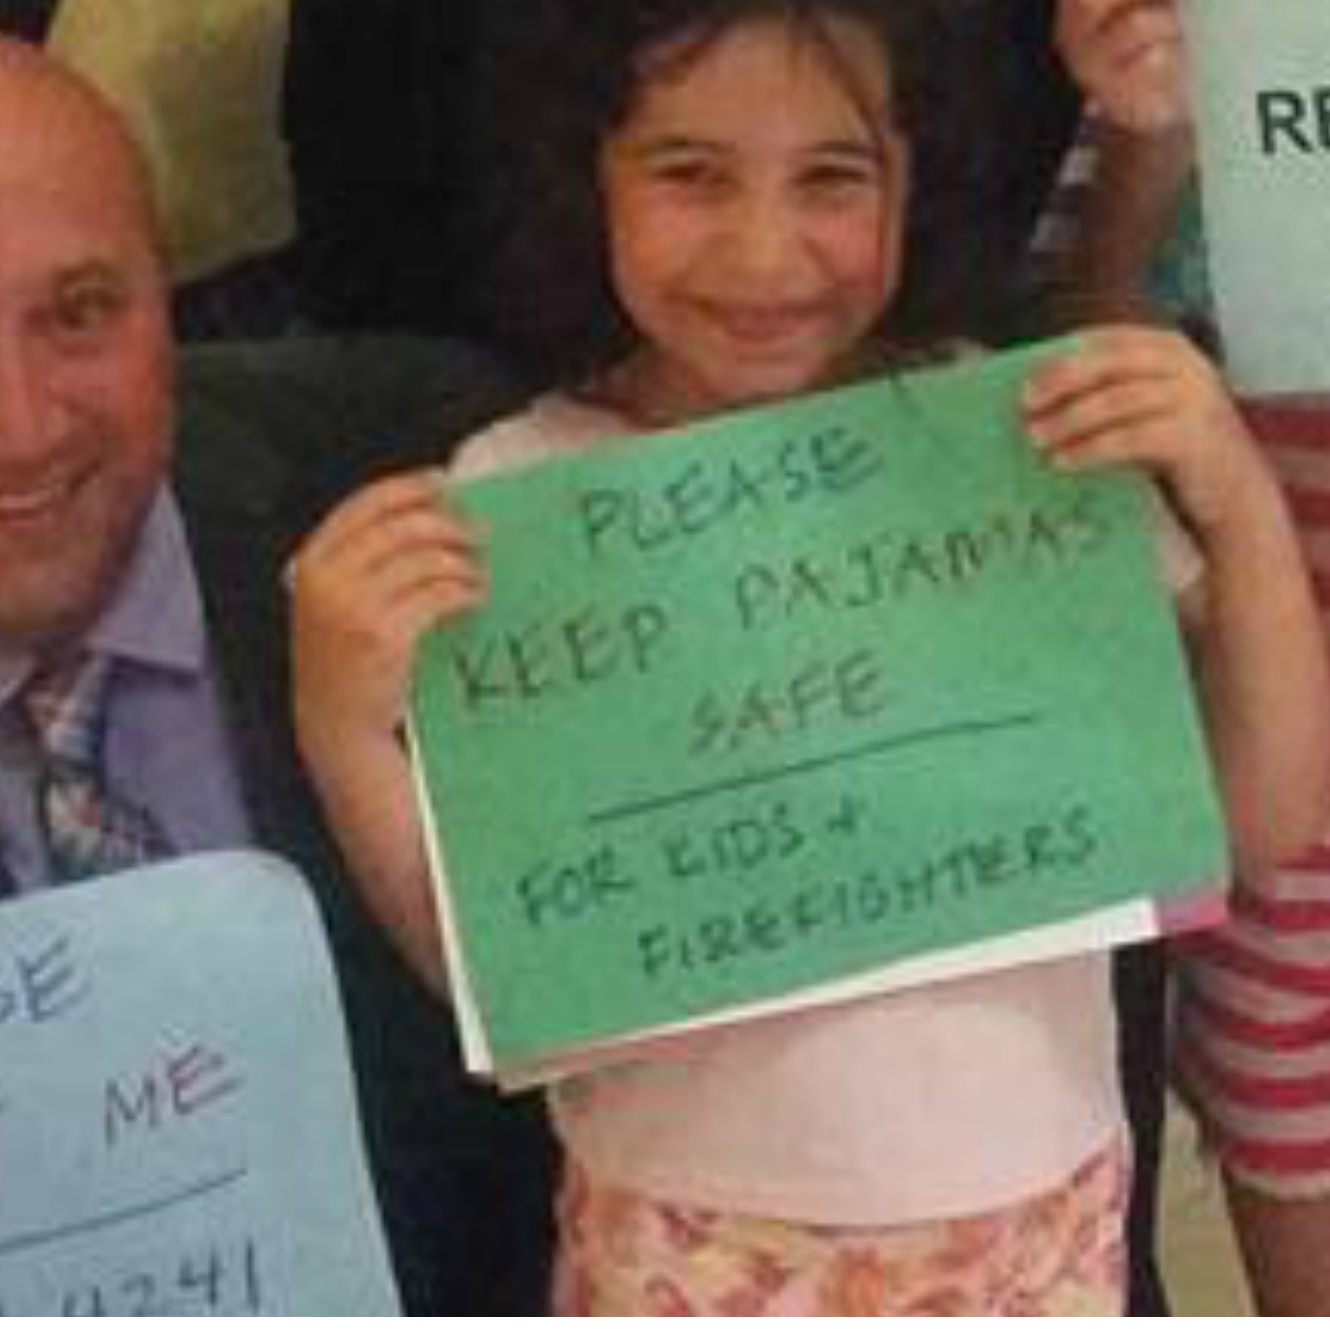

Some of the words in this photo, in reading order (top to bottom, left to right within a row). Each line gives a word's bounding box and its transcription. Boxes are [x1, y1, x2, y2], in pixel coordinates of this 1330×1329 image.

[581, 425, 885, 557] PLEASE
[451, 599, 669, 710] KEEP
[735, 492, 1116, 631] PAJAMAS
[691, 650, 889, 752] SAFE
[518, 848, 634, 926] FOR
[667, 803, 805, 876] KIDS
[639, 806, 1099, 977] FIREFIGHTERS
[103, 1043, 243, 1145] ME
